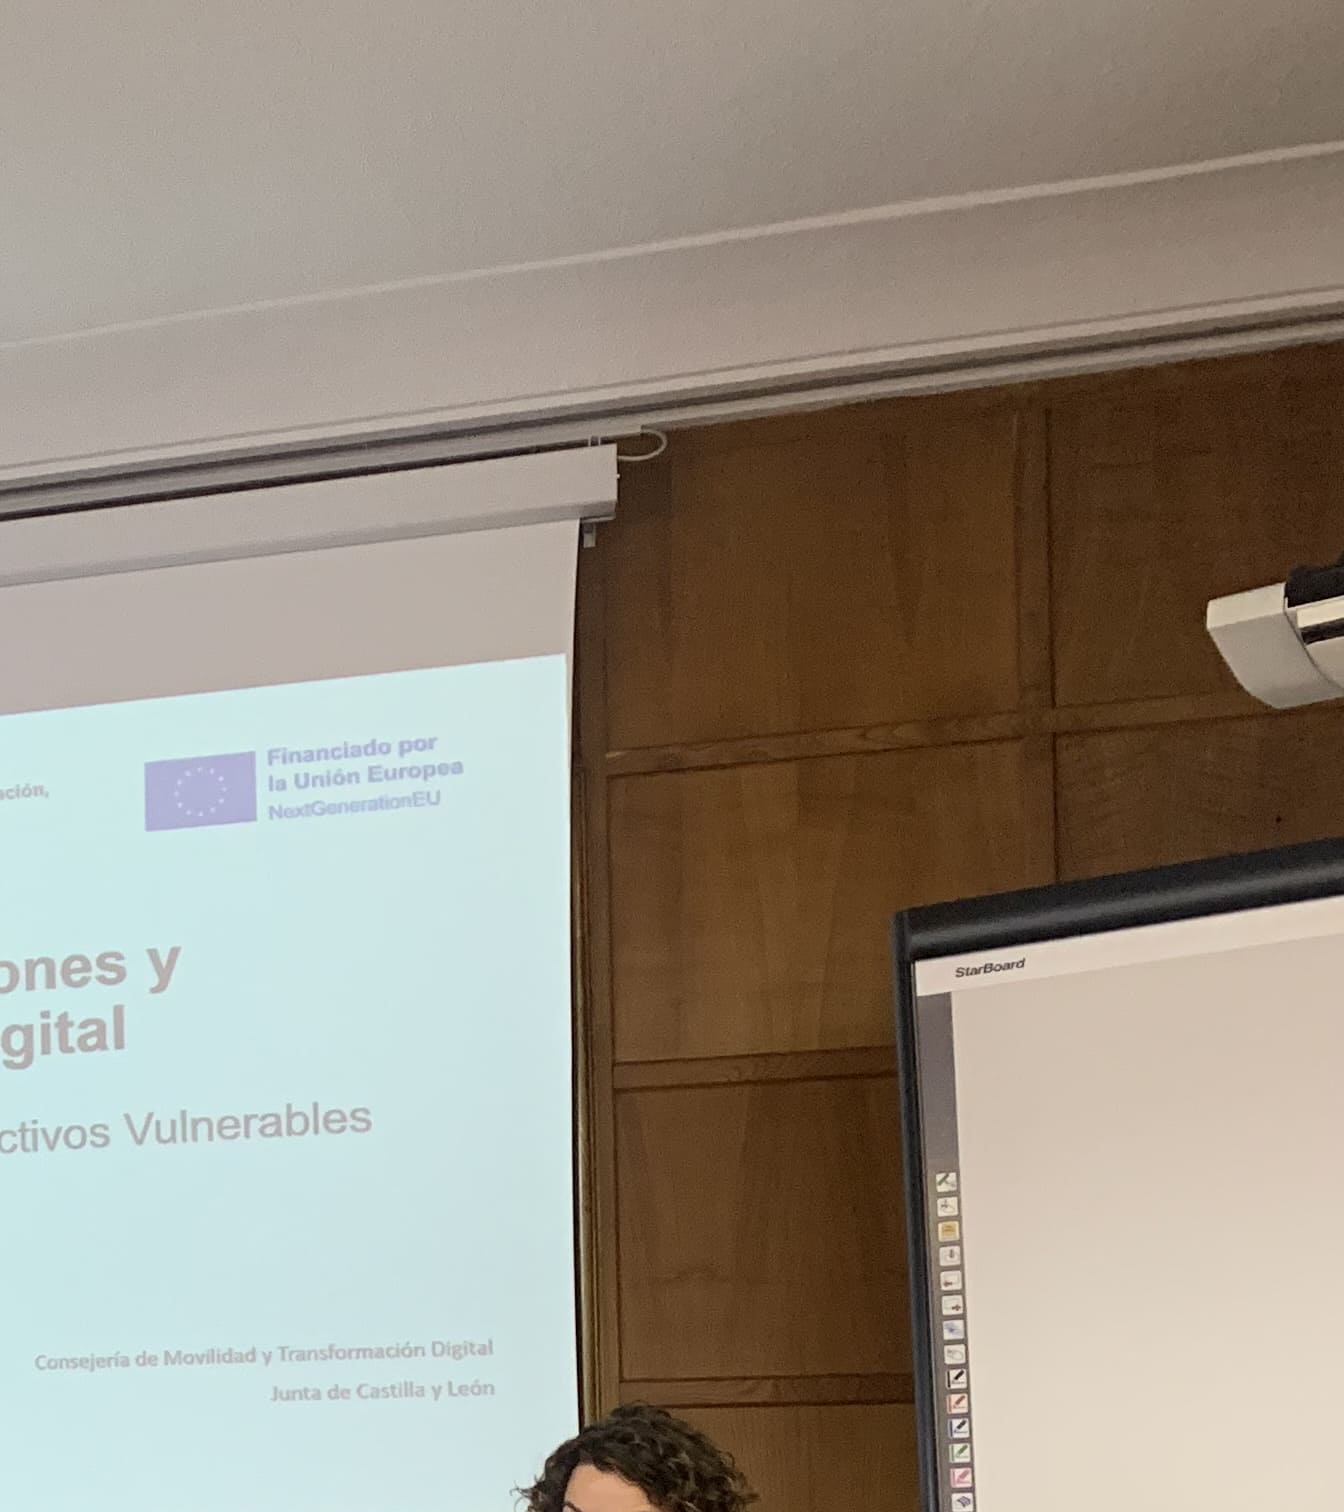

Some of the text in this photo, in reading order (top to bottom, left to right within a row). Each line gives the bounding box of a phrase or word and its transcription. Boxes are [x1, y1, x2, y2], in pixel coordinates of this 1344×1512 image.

[268, 737, 437, 766] Financiado por
[269, 761, 464, 792] la Unión Europea
[268, 790, 440, 820] NextGenerationEU
[146, 947, 181, 994] y
[956, 958, 1025, 977] StarBoard
[123, 1102, 372, 1146] Vulnerables
[35, 1339, 493, 1372] Consejería de Movilidad y Transformación Digital
[270, 1379, 495, 1402] Junta de Castilla y León
